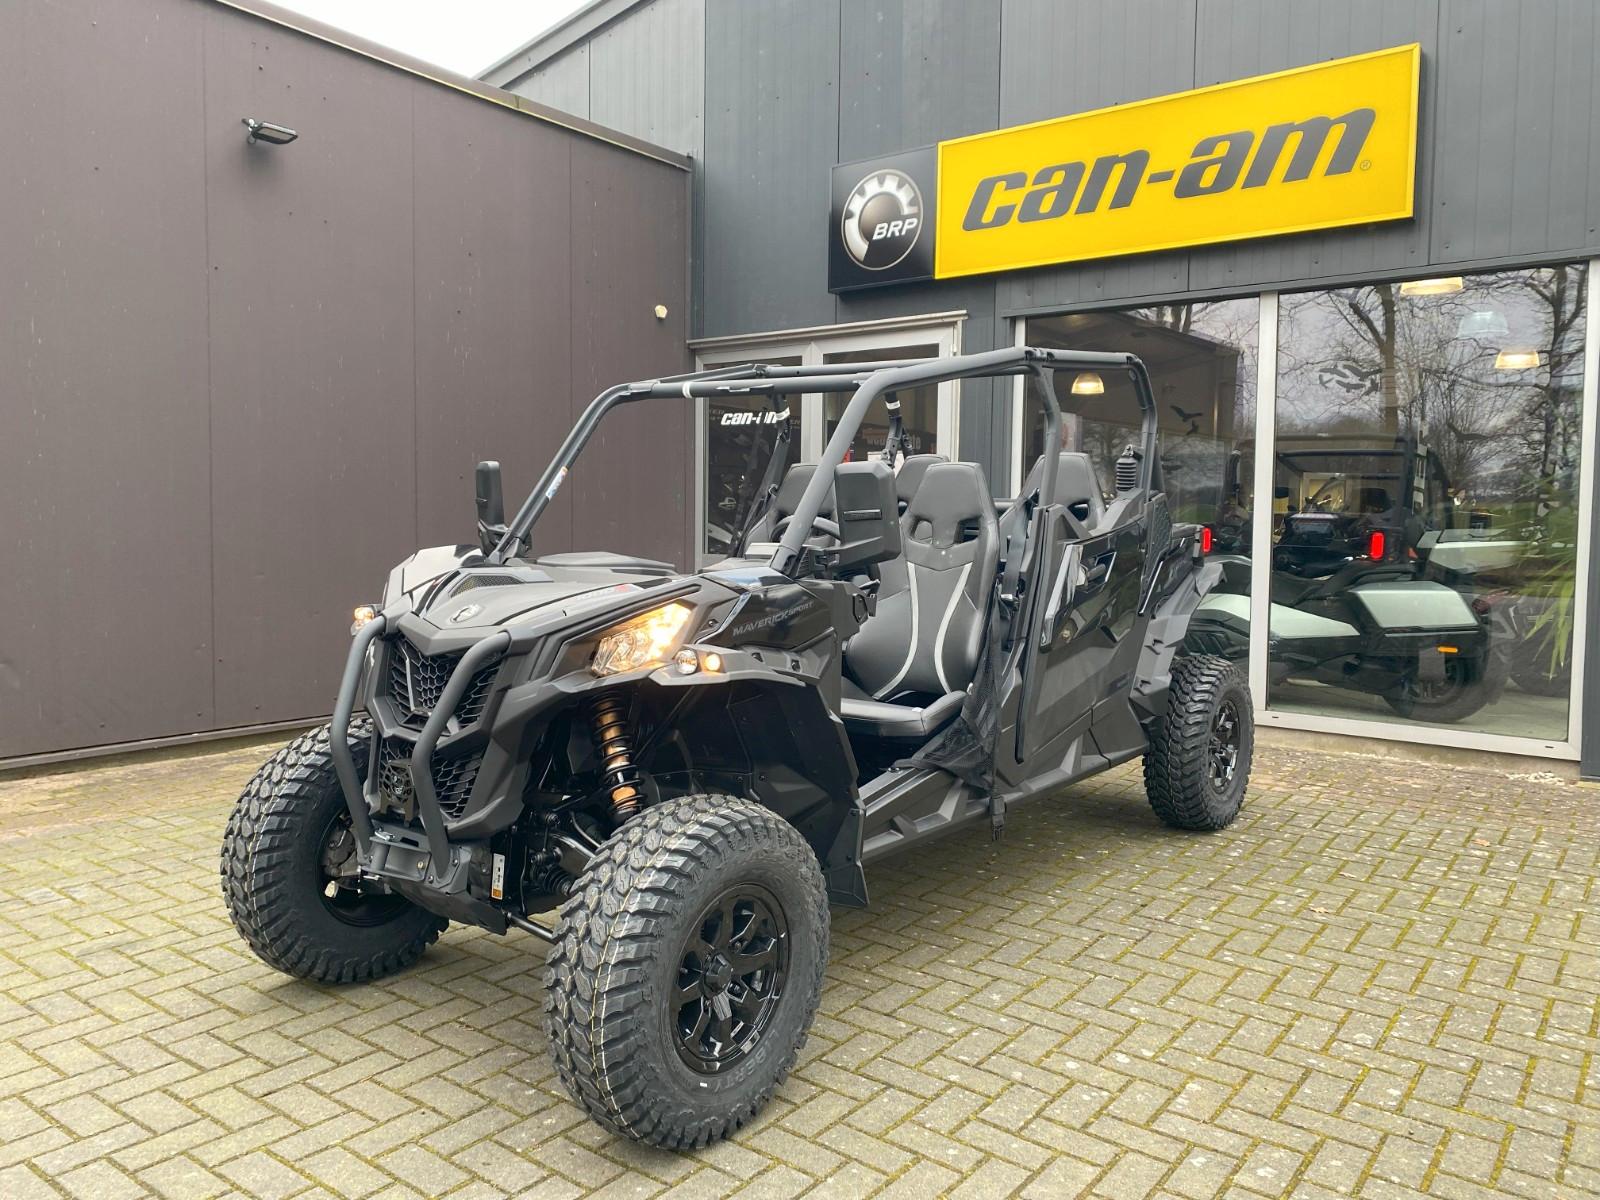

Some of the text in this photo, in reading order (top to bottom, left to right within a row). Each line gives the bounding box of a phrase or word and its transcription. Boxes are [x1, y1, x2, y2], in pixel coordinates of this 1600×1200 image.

[963, 108, 1376, 231] can-am
[872, 217, 918, 241] BRP
[732, 609, 789, 636] MAVERICK
